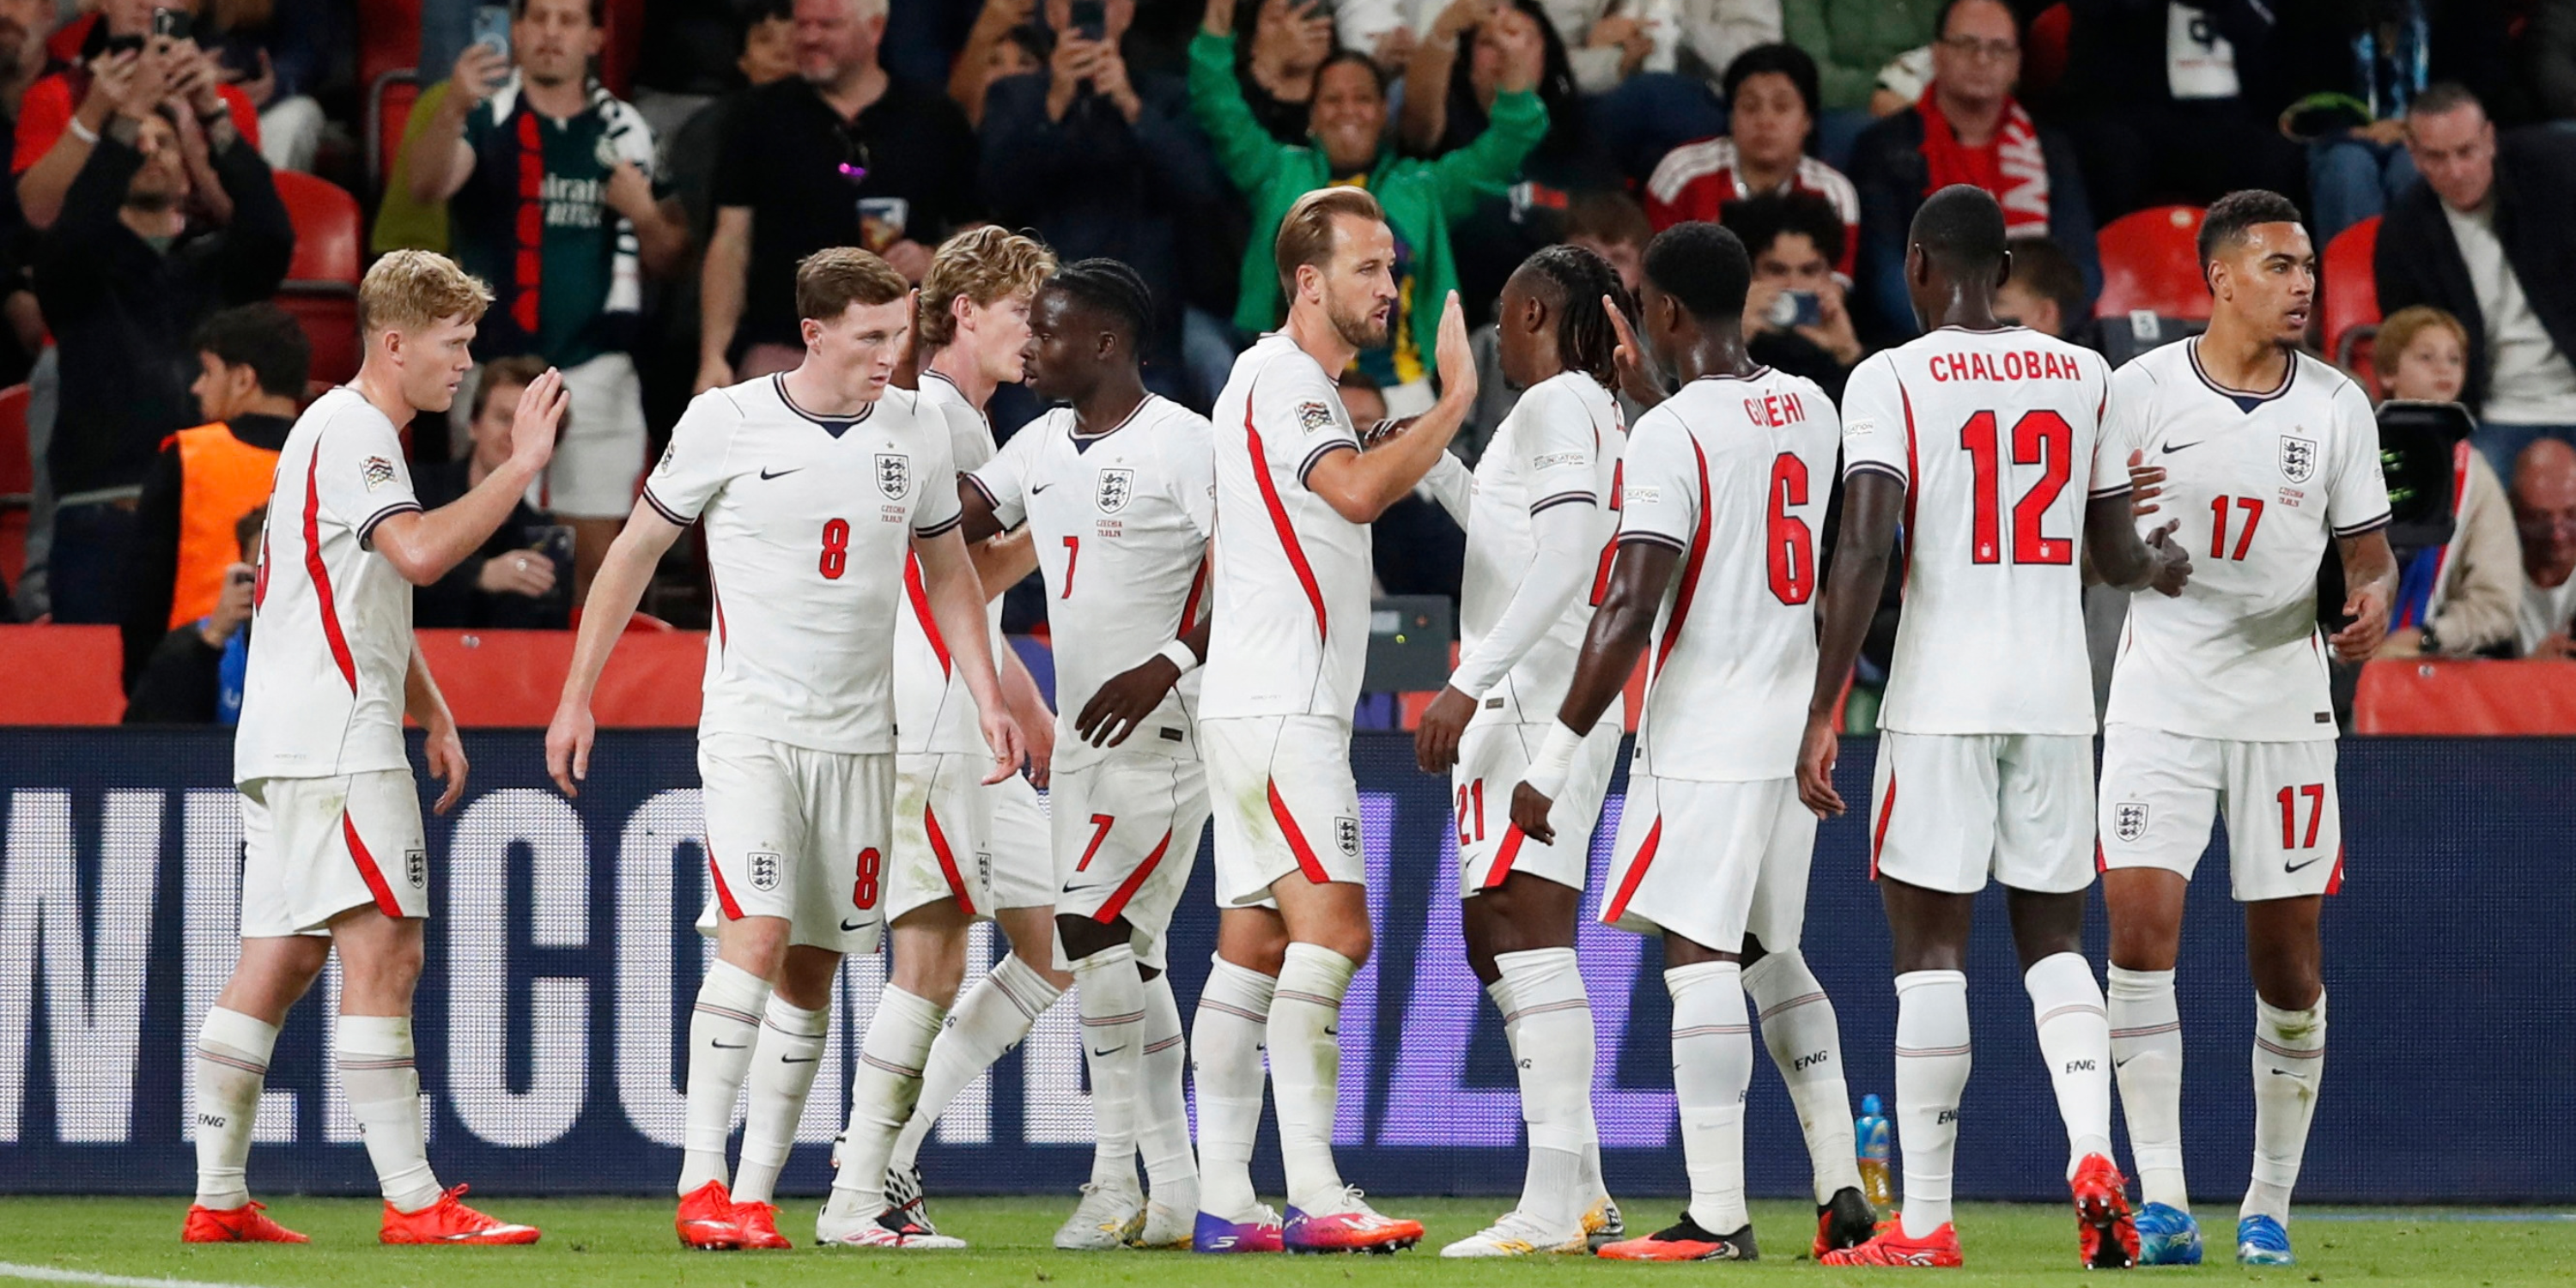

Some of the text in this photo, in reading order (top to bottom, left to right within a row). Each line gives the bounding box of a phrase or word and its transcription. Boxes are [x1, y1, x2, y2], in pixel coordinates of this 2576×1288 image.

[1929, 350, 2081, 382] CHALOBAH
[1743, 389, 1806, 428] GUÉHI
[1960, 410, 2072, 565] 12
[819, 518, 850, 580] 8
[1766, 452, 1814, 606] 6
[2210, 495, 2264, 561] 17
[1060, 536, 1079, 599] 7
[1076, 813, 1115, 872] 7
[1455, 777, 1484, 847] 21
[2276, 782, 2324, 849] 17
[852, 847, 880, 910] 8
[1795, 1050, 1827, 1072] ENG
[2065, 1059, 2096, 1074] ENG
[197, 1113, 226, 1128] ENG
[1937, 1109, 1959, 1125] EN
